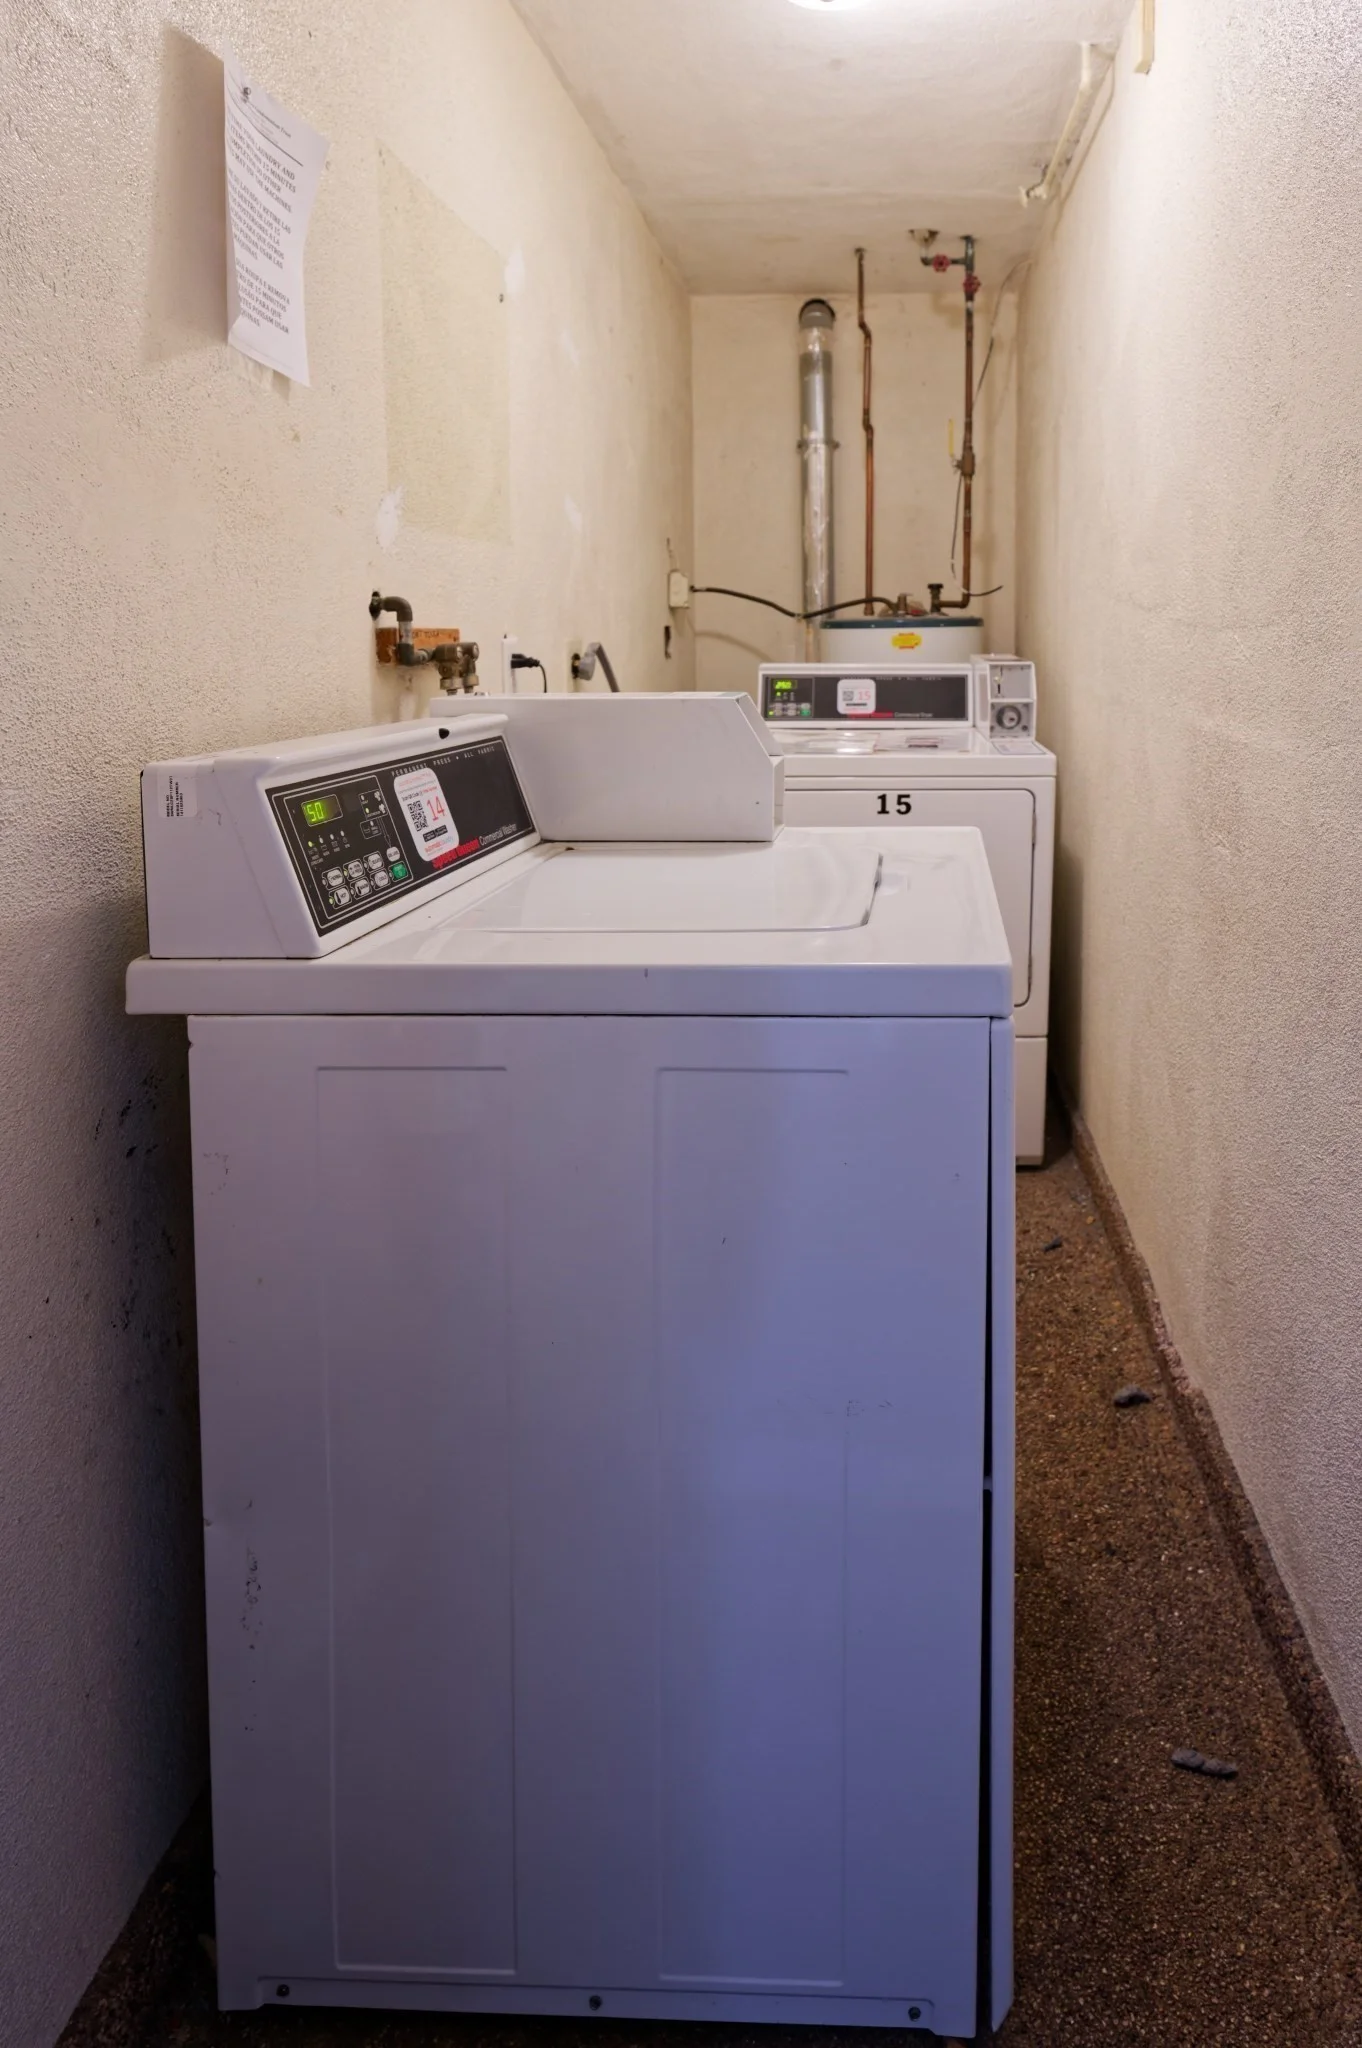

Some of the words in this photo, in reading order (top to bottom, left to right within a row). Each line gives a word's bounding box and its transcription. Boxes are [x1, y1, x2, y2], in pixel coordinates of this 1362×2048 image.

[255, 143, 281, 170] LAUNDRY
[282, 166, 295, 181] AND
[263, 172, 281, 192] OTHER
[270, 168, 297, 193] MINUTES
[238, 190, 257, 214] DENTRO
[263, 206, 281, 227] RETIRE
[281, 222, 291, 235] LAS
[259, 246, 273, 262] USAR
[273, 256, 283, 270] LAS
[255, 298, 270, 311] PARA
[270, 308, 283, 320] QUE
[262, 291, 287, 313] MINUTOS
[274, 319, 289, 334] USAR
[857, 690, 871, 701] 15
[391, 763, 428, 777] PERMANENT
[432, 757, 452, 767] PRESS
[464, 751, 474, 759] ALL
[478, 746, 495, 755] FABRIC
[426, 795, 446, 822] 14
[876, 793, 913, 815] 15
[479, 828, 503, 846] Commercial
[502, 823, 517, 835] Washer
